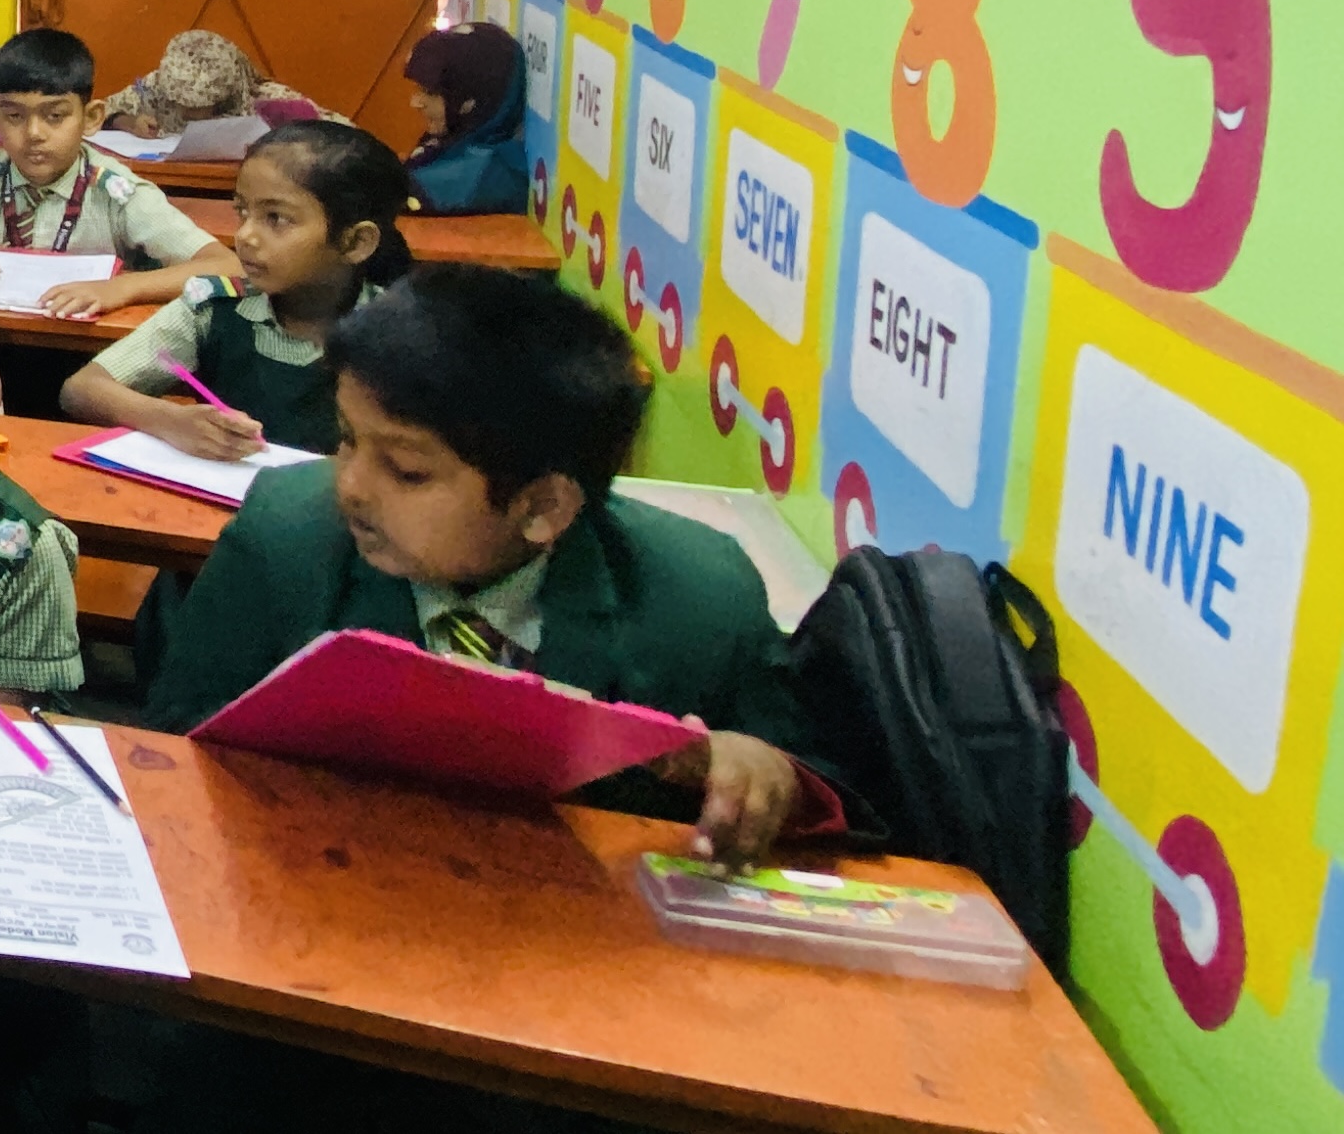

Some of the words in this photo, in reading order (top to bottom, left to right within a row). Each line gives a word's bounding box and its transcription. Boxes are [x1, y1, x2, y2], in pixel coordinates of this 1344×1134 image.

[576, 73, 601, 127] FIVE
[648, 117, 674, 174] SIX
[735, 170, 800, 282] SEVEN
[870, 278, 957, 399] EIGHT
[1104, 444, 1245, 641] NINE
[37, 930, 80, 942] Vision
